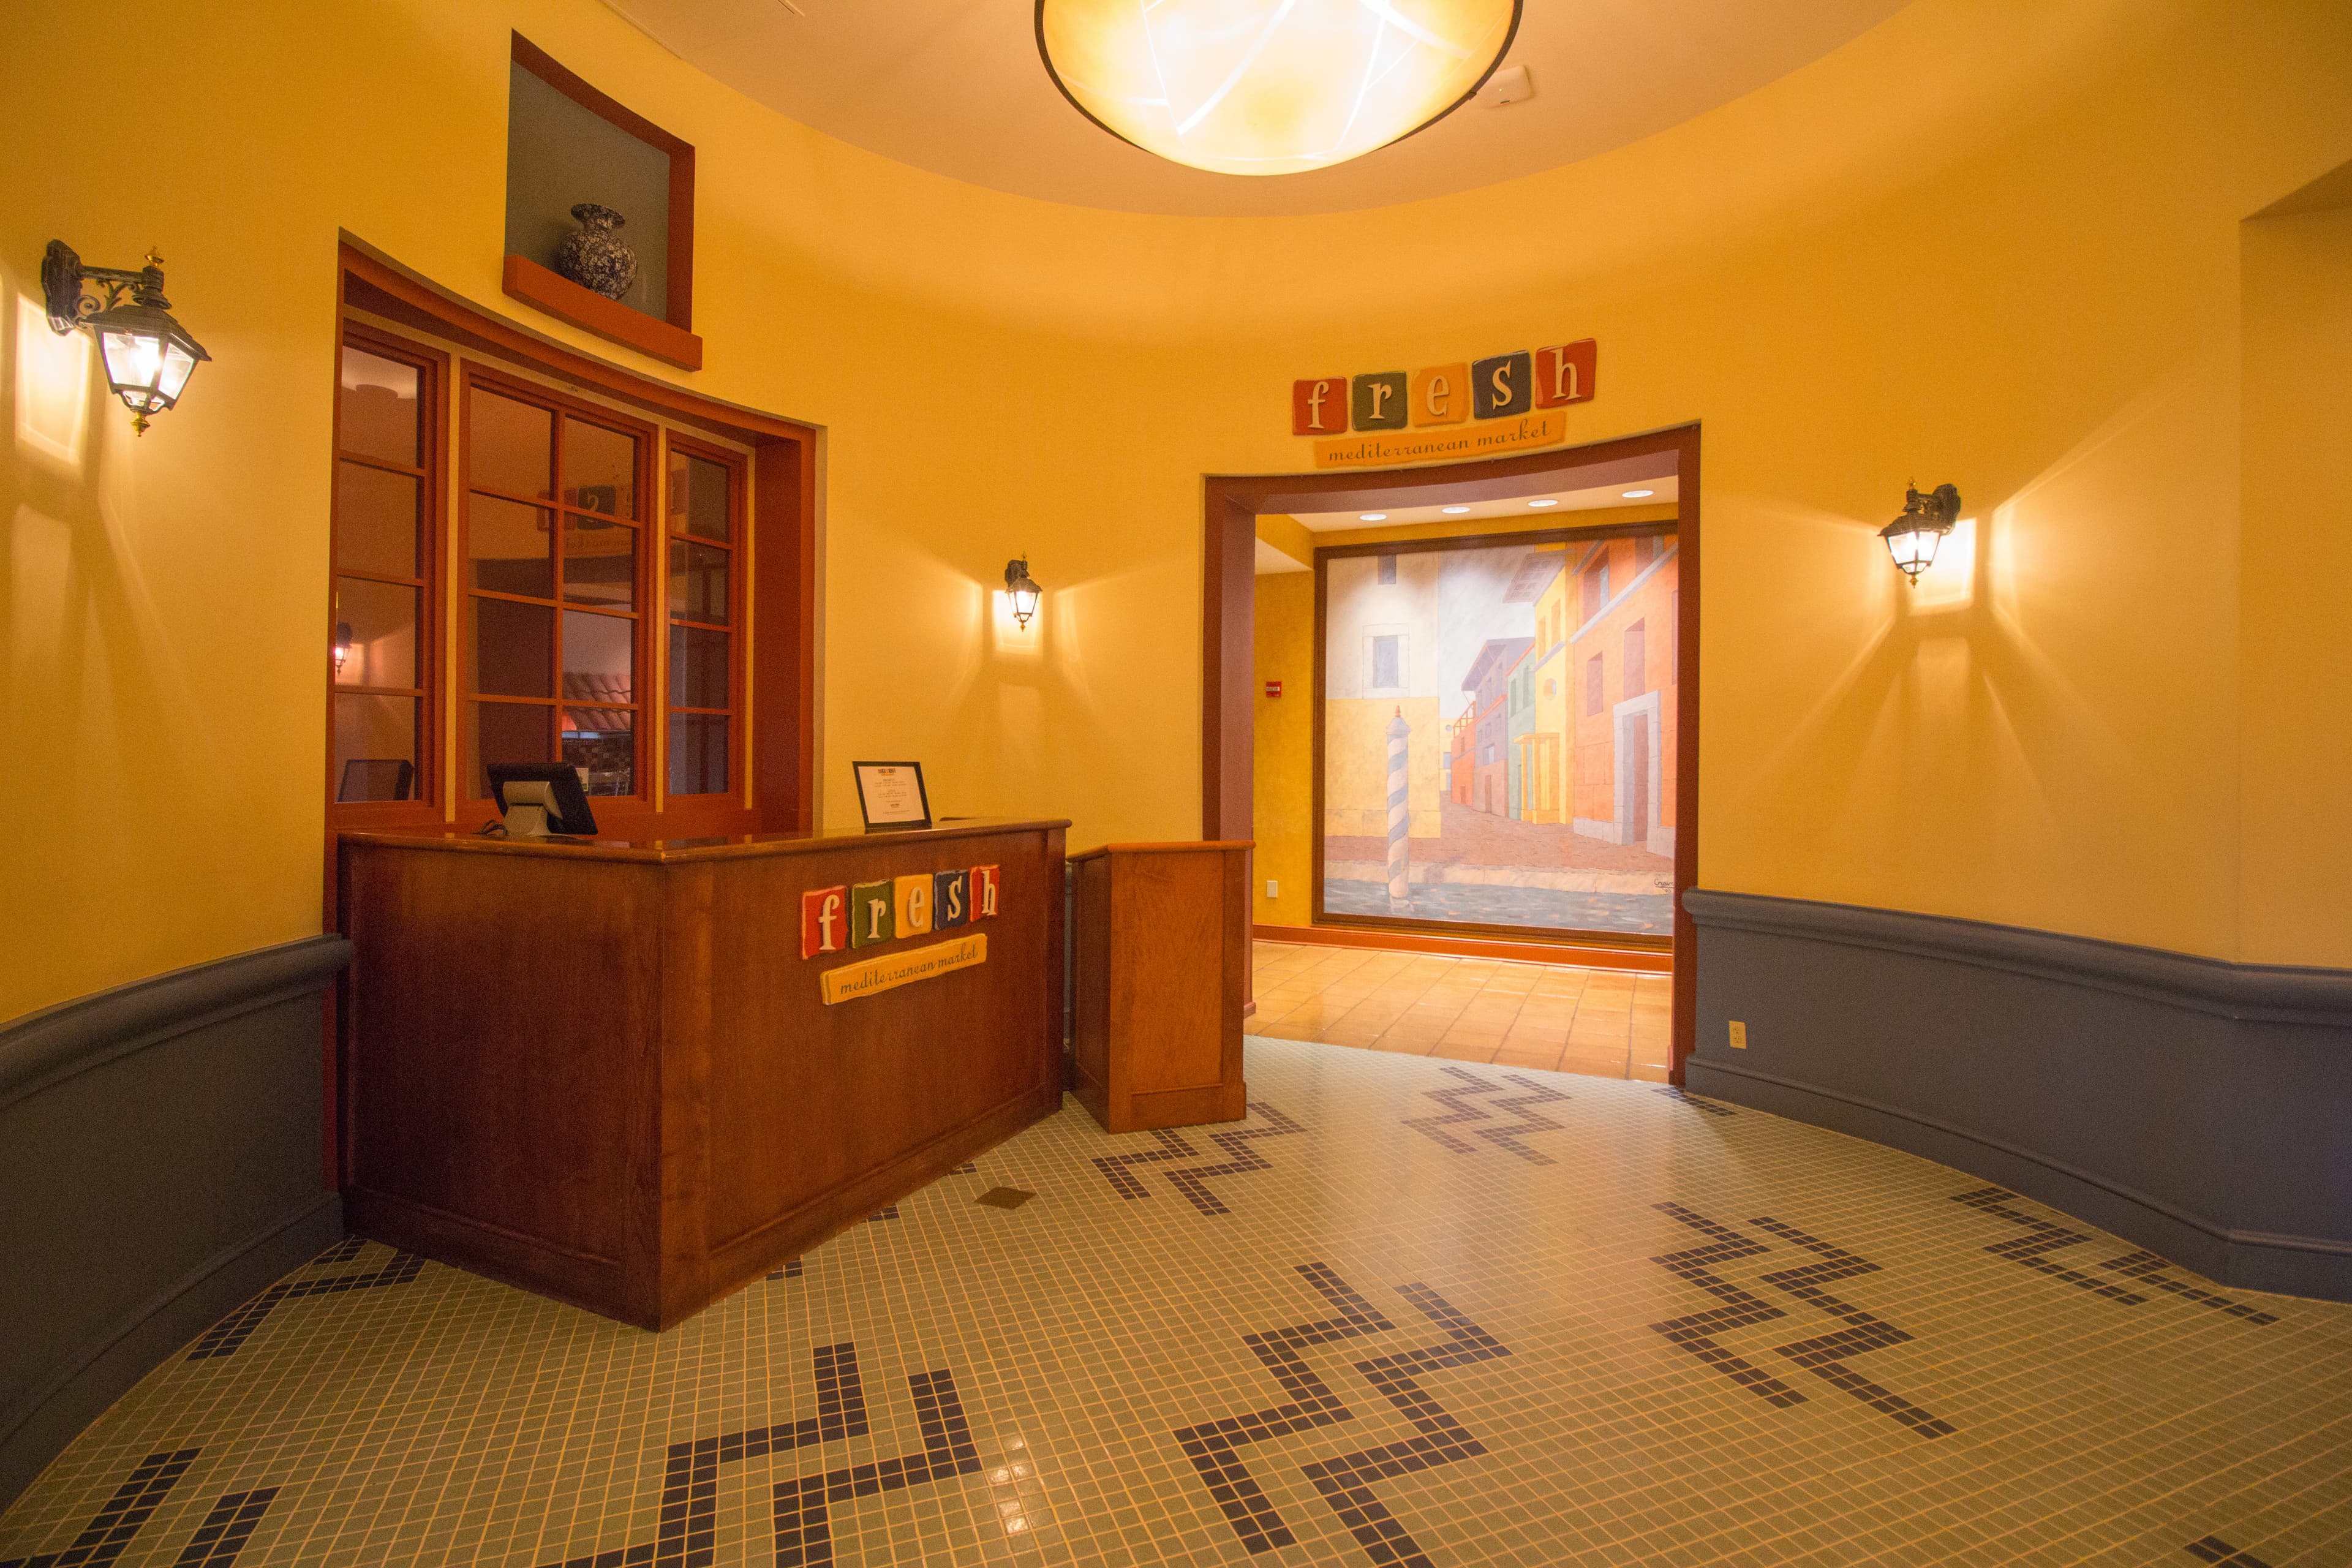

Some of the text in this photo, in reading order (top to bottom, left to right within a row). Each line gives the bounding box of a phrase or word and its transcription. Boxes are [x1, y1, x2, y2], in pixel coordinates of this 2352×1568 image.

[1307, 347, 1582, 429] fresh
[1328, 418, 1550, 461] mediterranean market
[818, 870, 997, 951] fresh
[840, 942, 979, 995] mediterranean market
